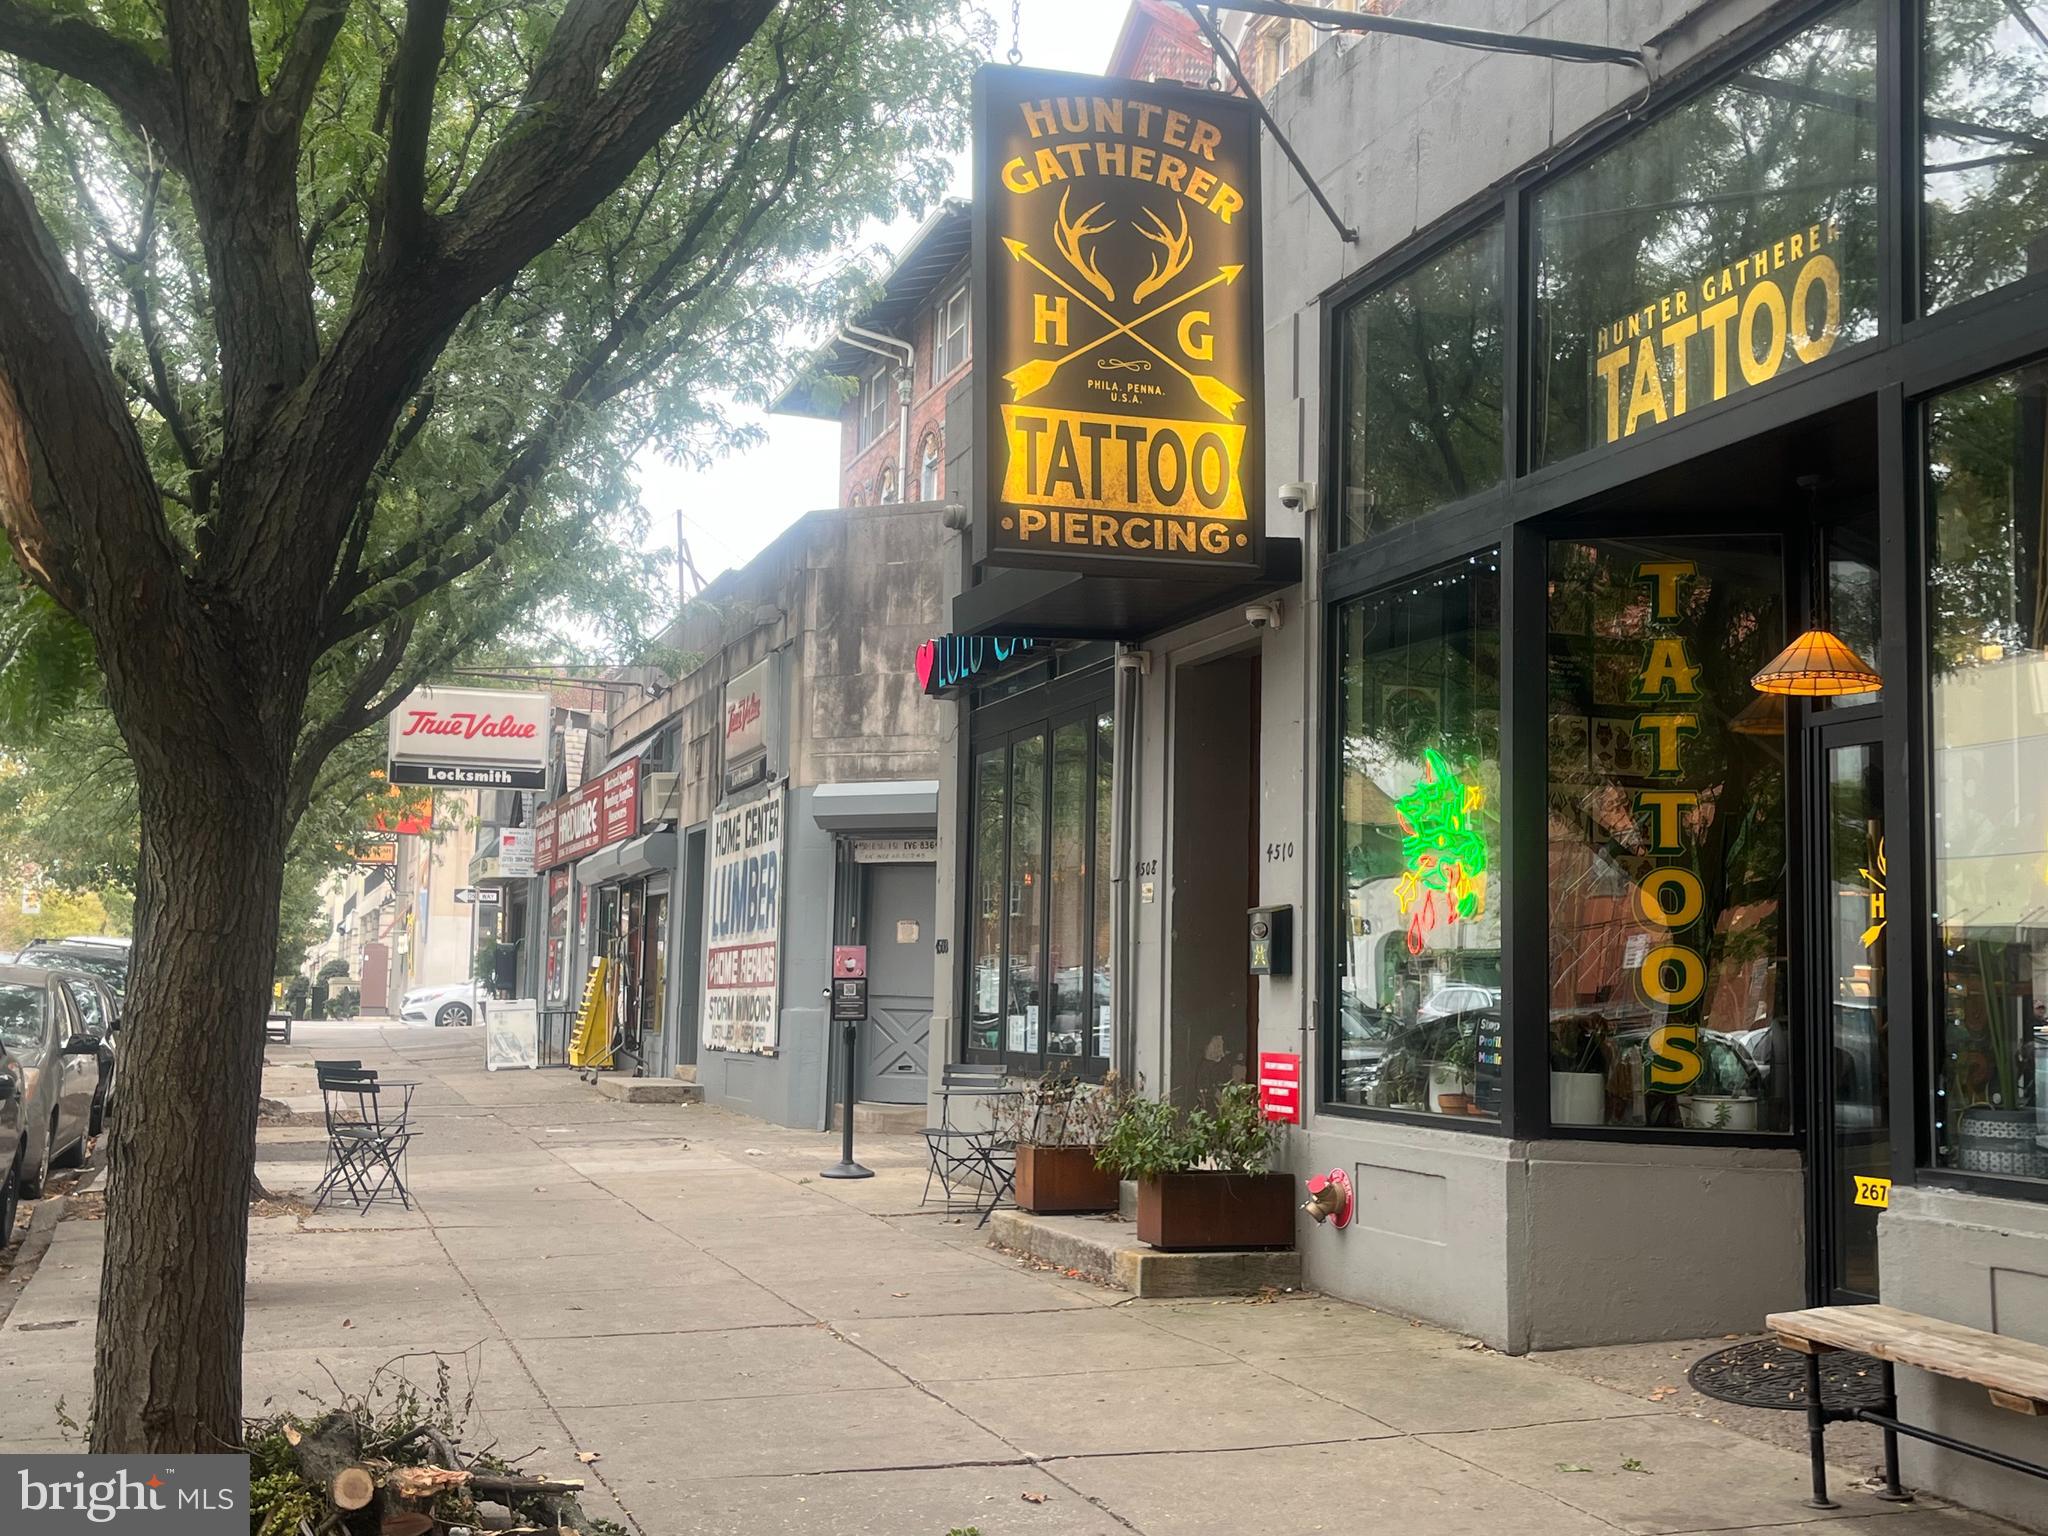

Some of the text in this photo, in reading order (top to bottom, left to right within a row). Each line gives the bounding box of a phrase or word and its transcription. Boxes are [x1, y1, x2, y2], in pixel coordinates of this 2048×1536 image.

[1020, 96, 1222, 162] HUNTER
[1001, 141, 1244, 225] GATHERER
[1599, 214, 1841, 352] HUNTER GATHERER
[1033, 293, 1214, 361] H G
[1597, 254, 1841, 443] TATTOO
[1087, 379, 1167, 396] PHILA. PENNA.
[1110, 393, 1144, 405] U.S.A.
[1014, 415, 1231, 510] TATTOO
[1018, 508, 1231, 554] PIERCING
[426, 767, 513, 785] Locksmith
[715, 798, 779, 858] HOME CENTER
[1633, 561, 1706, 1094] TATTOOS
[1266, 841, 1294, 864] 4510
[481, 893, 496, 901] WAY
[711, 849, 778, 940] LUMBER
[1871, 893, 1885, 919] H
[713, 946, 775, 985] HOME REPAIRS
[709, 995, 772, 1023] STORM WINDOWS
[1480, 1018, 1501, 1033] Stop
[1861, 1183, 1887, 1202] 267
